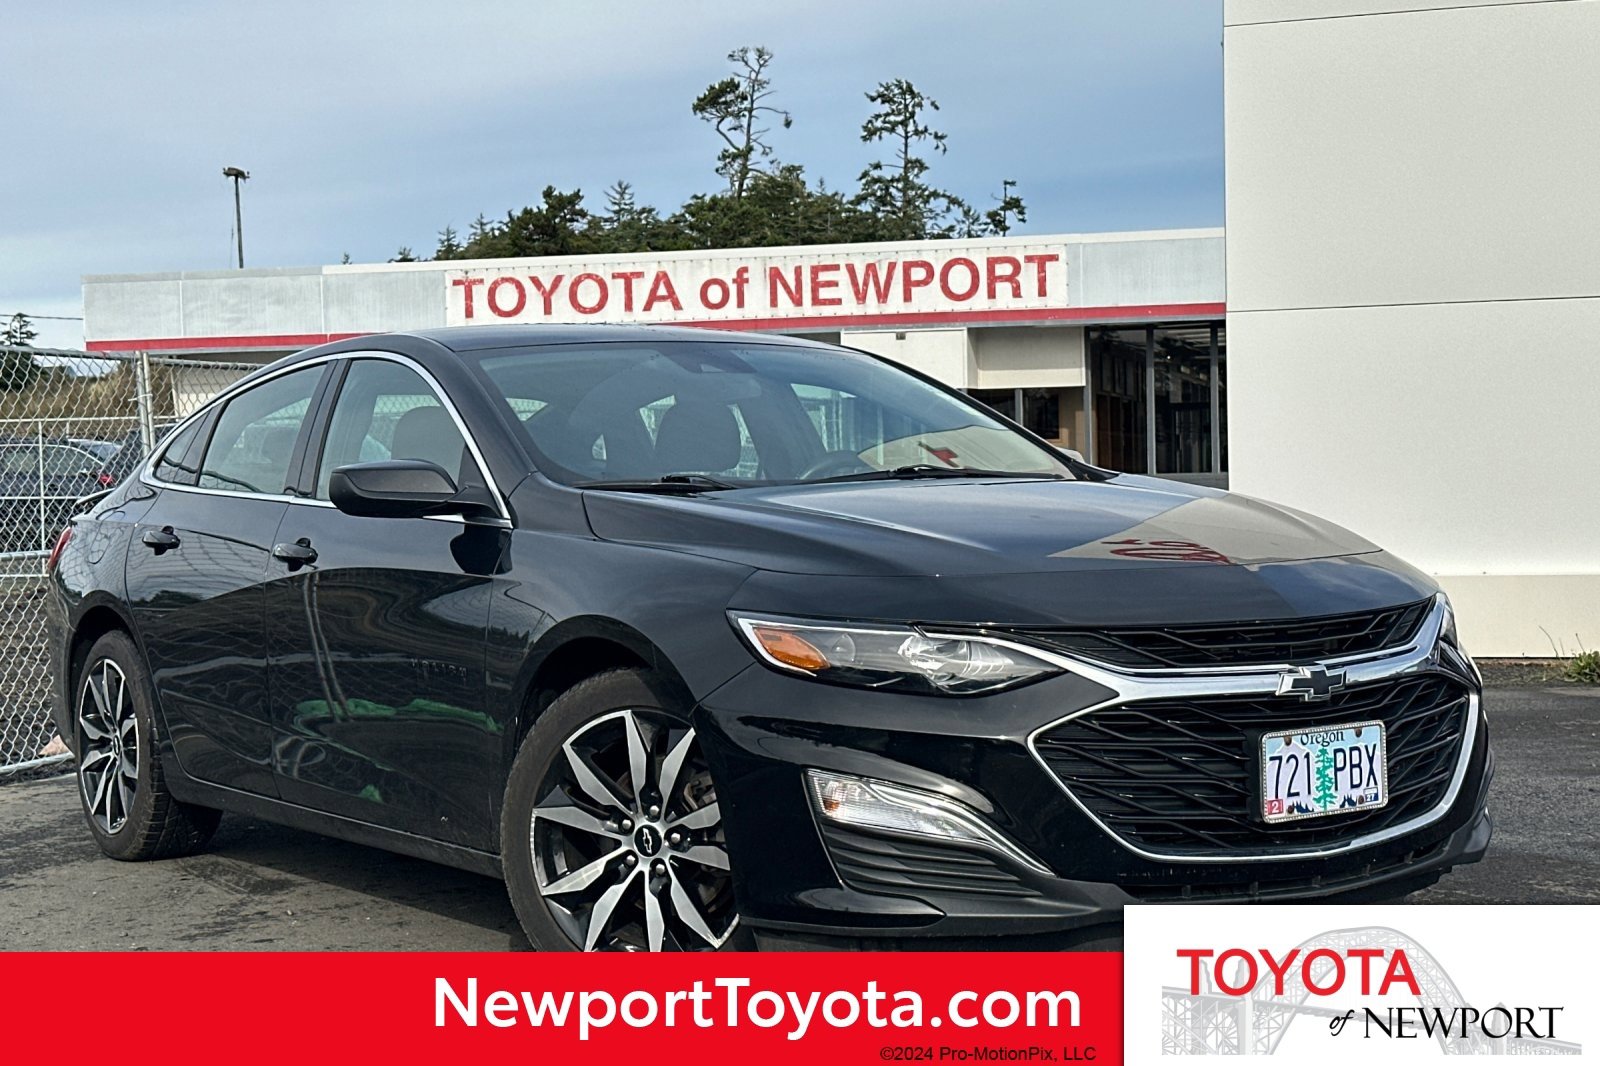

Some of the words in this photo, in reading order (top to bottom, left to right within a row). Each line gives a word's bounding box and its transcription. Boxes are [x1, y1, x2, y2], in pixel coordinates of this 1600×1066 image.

[453, 271, 683, 319] TOYOTA
[700, 266, 749, 310] of
[769, 254, 1060, 309] NEWPORT
[1300, 731, 1345, 746] Oregon
[1269, 752, 1312, 799] 721
[1333, 743, 1378, 792] PBX
